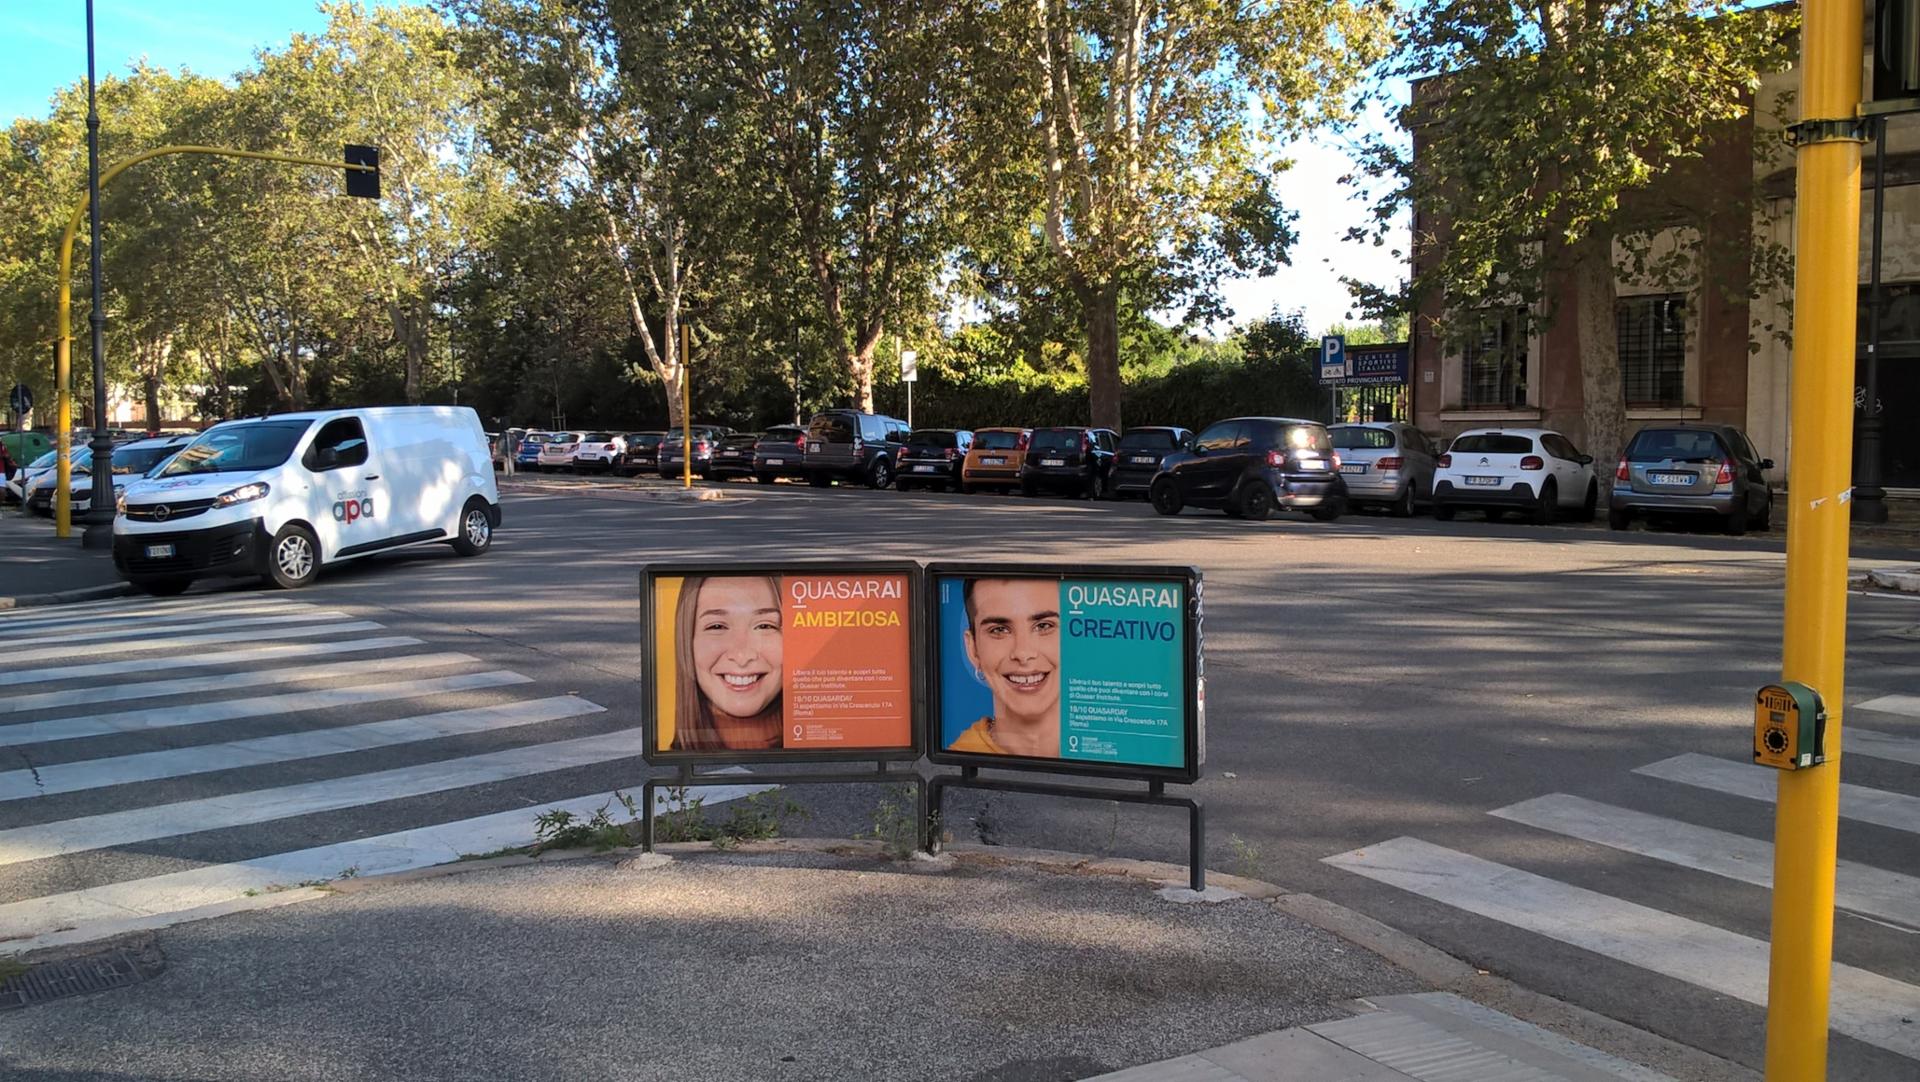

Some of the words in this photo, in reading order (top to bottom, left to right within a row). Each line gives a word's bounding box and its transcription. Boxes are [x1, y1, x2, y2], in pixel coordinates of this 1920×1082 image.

[1325, 338, 1340, 363] P
[332, 498, 374, 525] apa
[791, 580, 902, 606] QUASARAI
[1068, 586, 1178, 612] QUASARAI
[792, 610, 901, 628] AMBIZIOSA
[1068, 617, 1176, 642] CREATIVO
